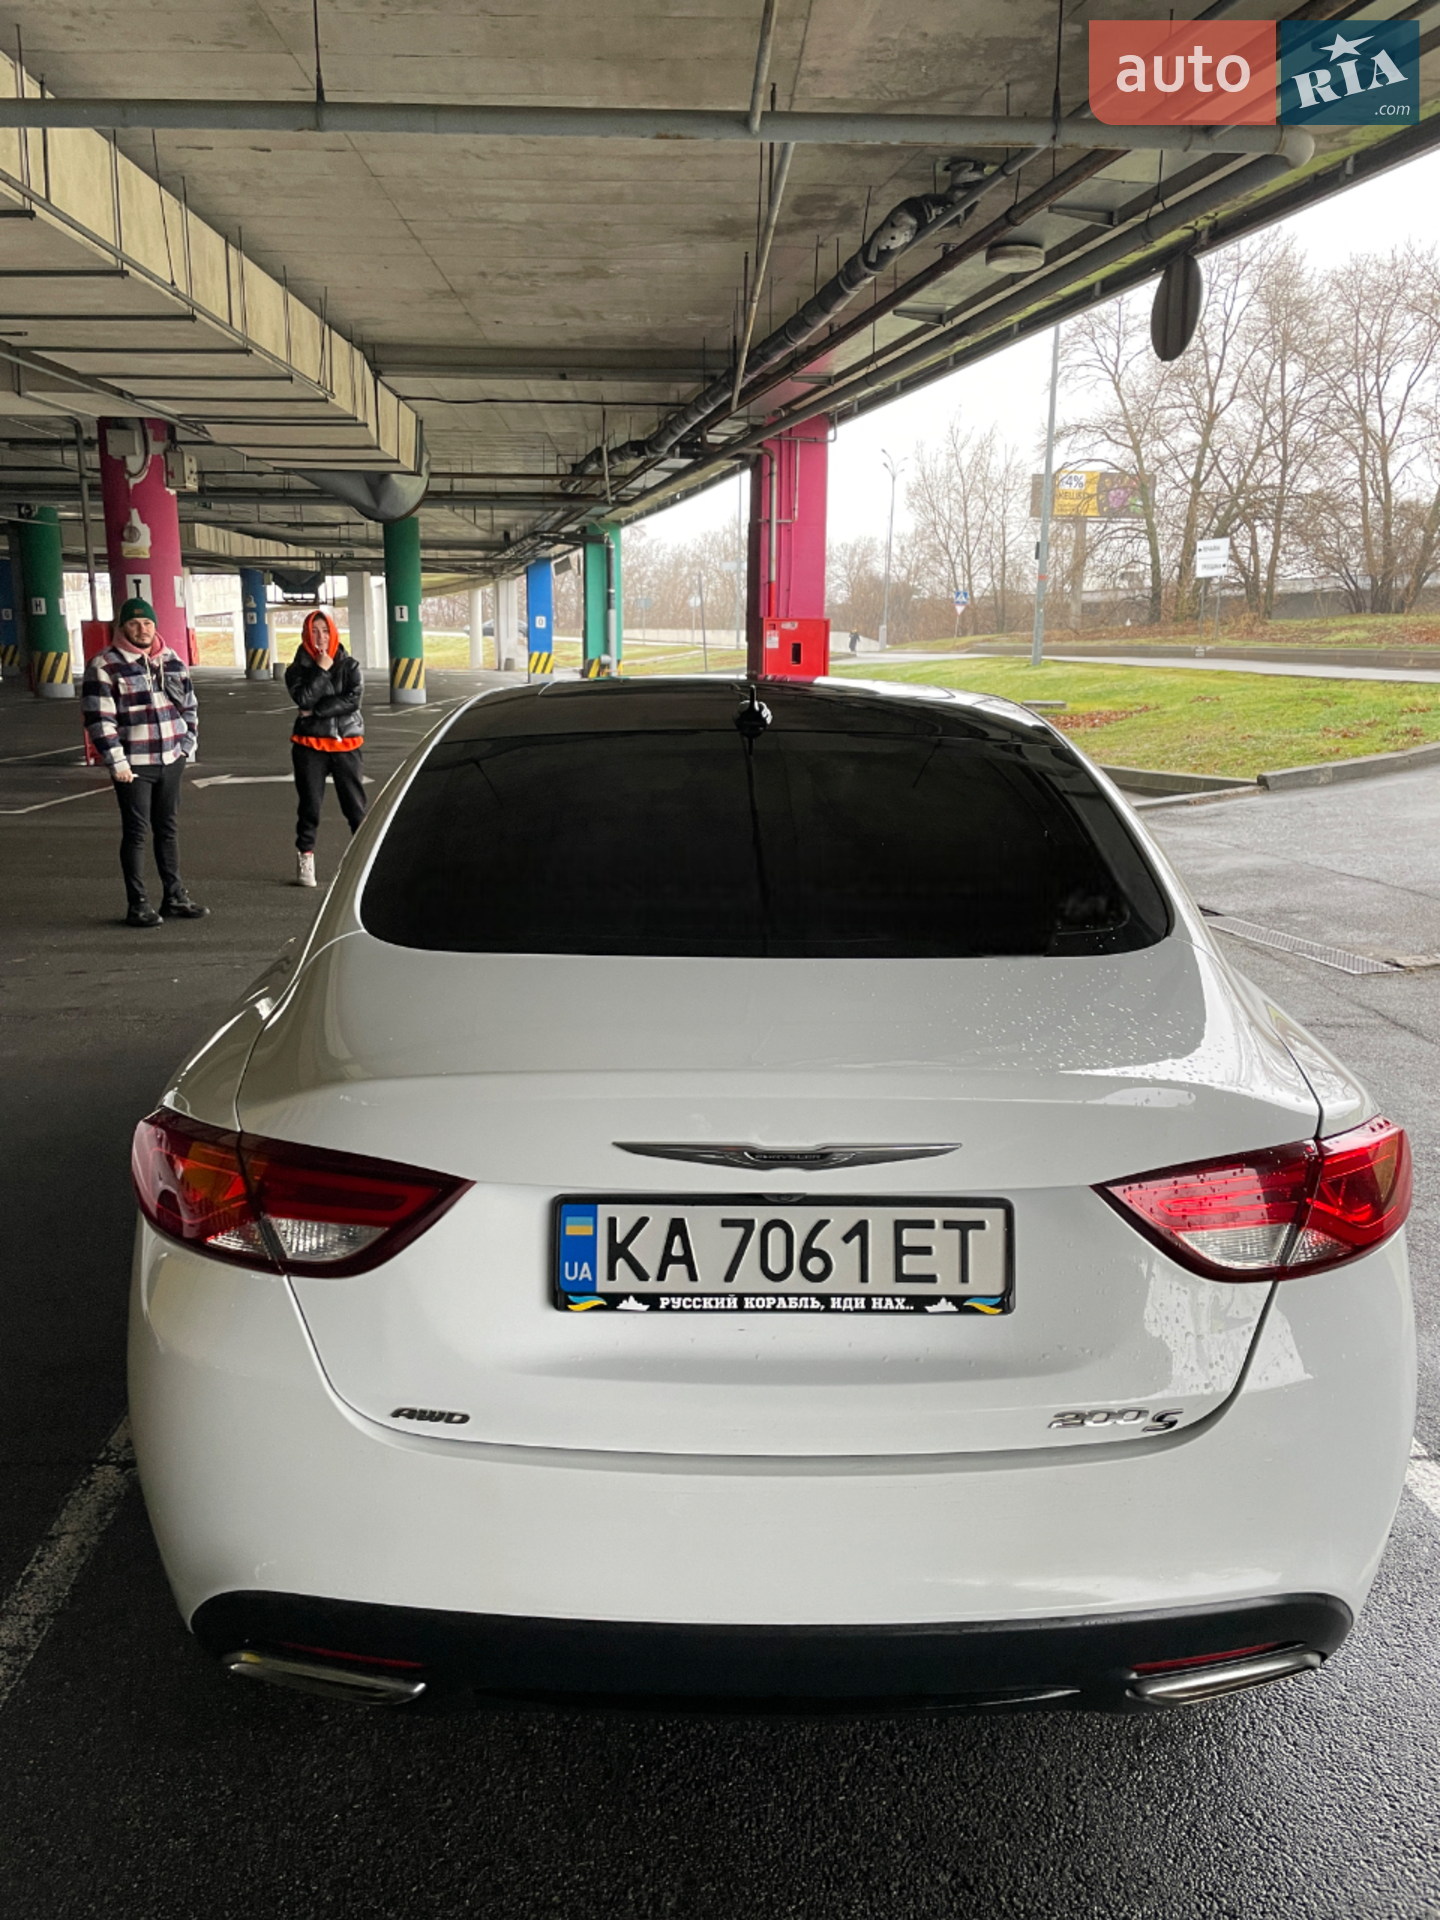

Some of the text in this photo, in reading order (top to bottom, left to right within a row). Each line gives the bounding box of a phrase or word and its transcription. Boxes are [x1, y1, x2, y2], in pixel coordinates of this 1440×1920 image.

[34, 599, 43, 612] H
[606, 1216, 987, 1285] KA 7061 ET
[565, 1261, 593, 1282] UA
[660, 1294, 740, 1310] РУССКИЙ
[744, 1295, 826, 1311] КОРАБЛЬ,
[830, 1296, 867, 1311] ИДИ
[390, 1406, 470, 1424] AWD
